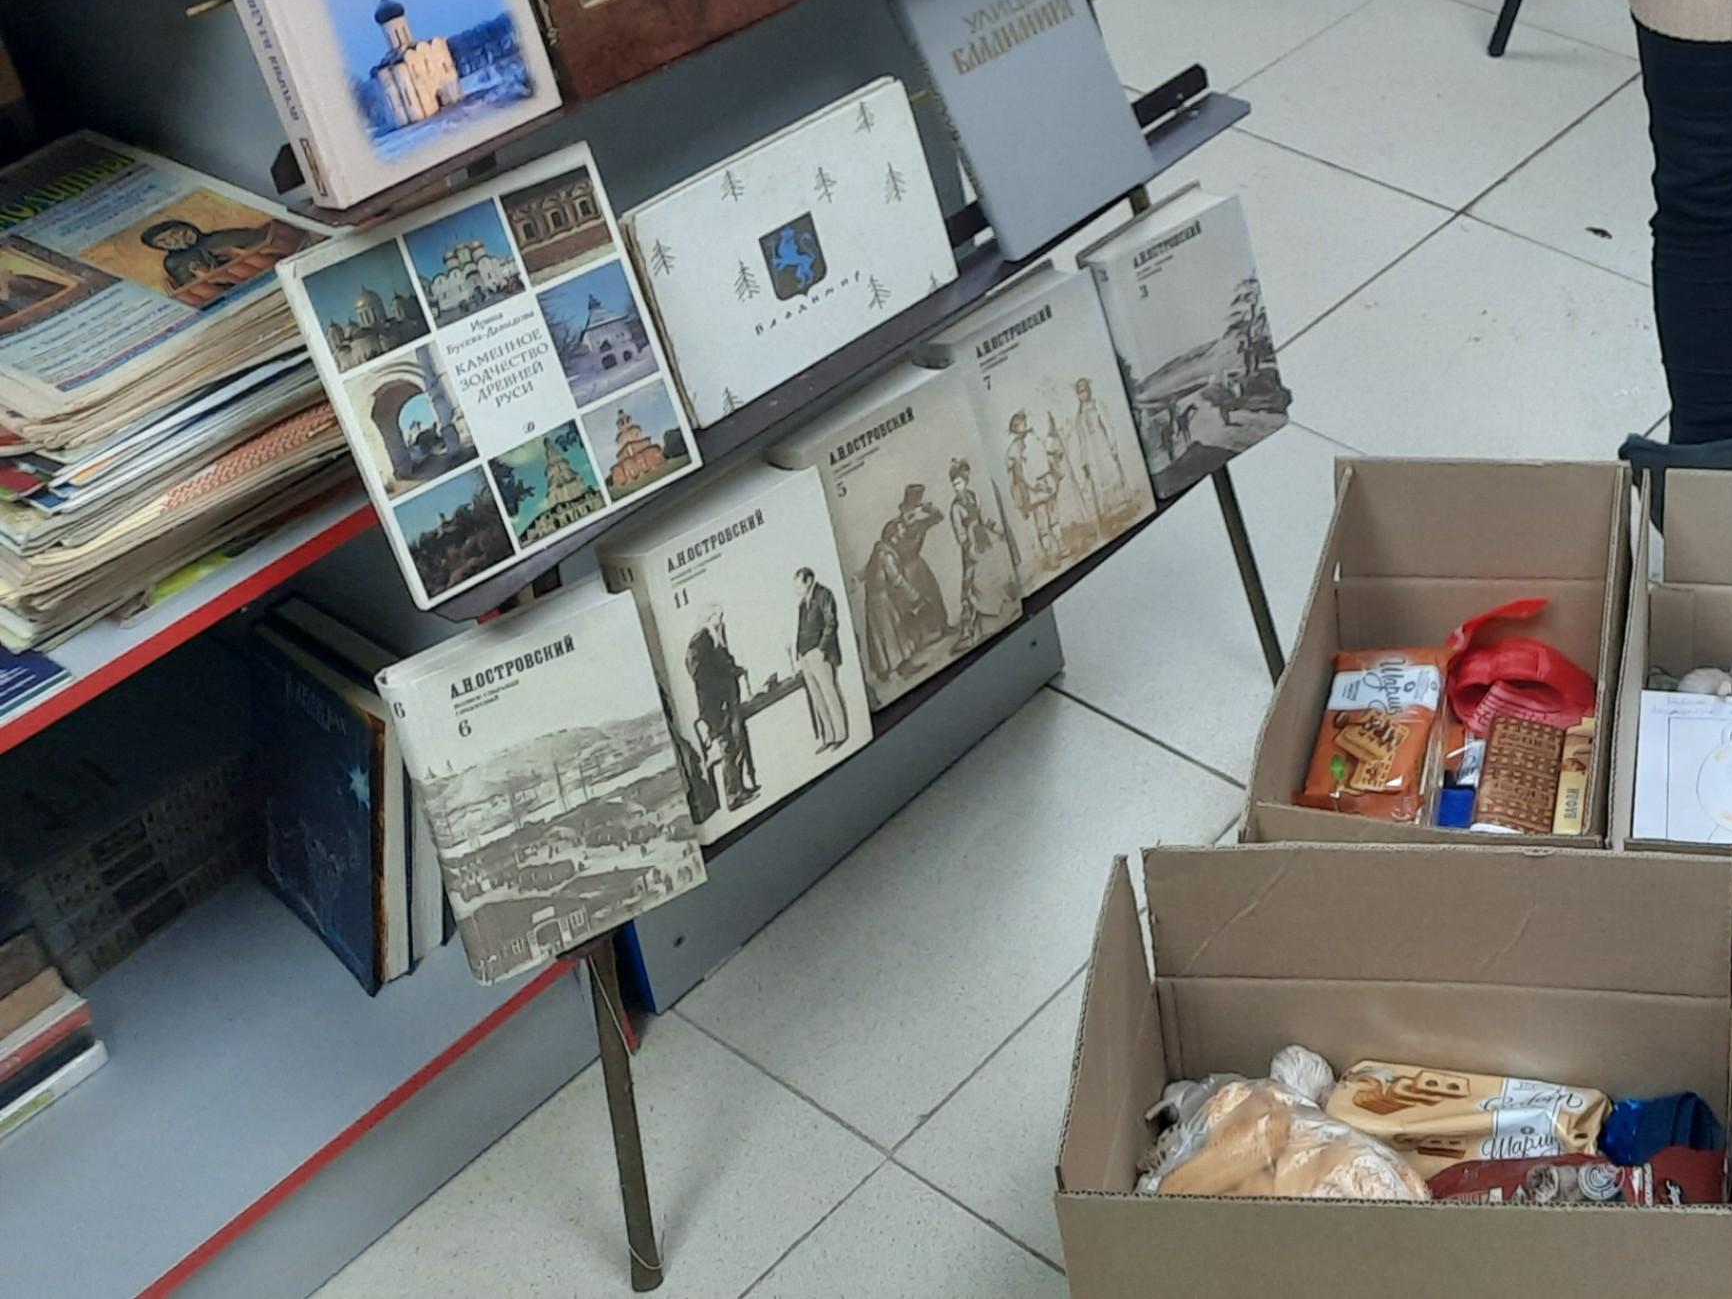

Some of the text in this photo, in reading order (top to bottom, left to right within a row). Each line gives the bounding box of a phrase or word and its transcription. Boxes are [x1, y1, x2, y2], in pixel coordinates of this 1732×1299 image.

[455, 328, 543, 376] КАМЕННОЕ
[459, 342, 549, 392] ЗОДЧЕСТВО
[478, 360, 544, 404] ДРЕВНЕЙ
[494, 380, 535, 408] РУСИ
[983, 374, 991, 391] 7
[836, 480, 848, 498] 5
[673, 588, 690, 610] 11
[450, 633, 576, 700] А.Н.ОСТРОВСКИЙ
[393, 701, 406, 719] 6
[458, 718, 473, 738] 6
